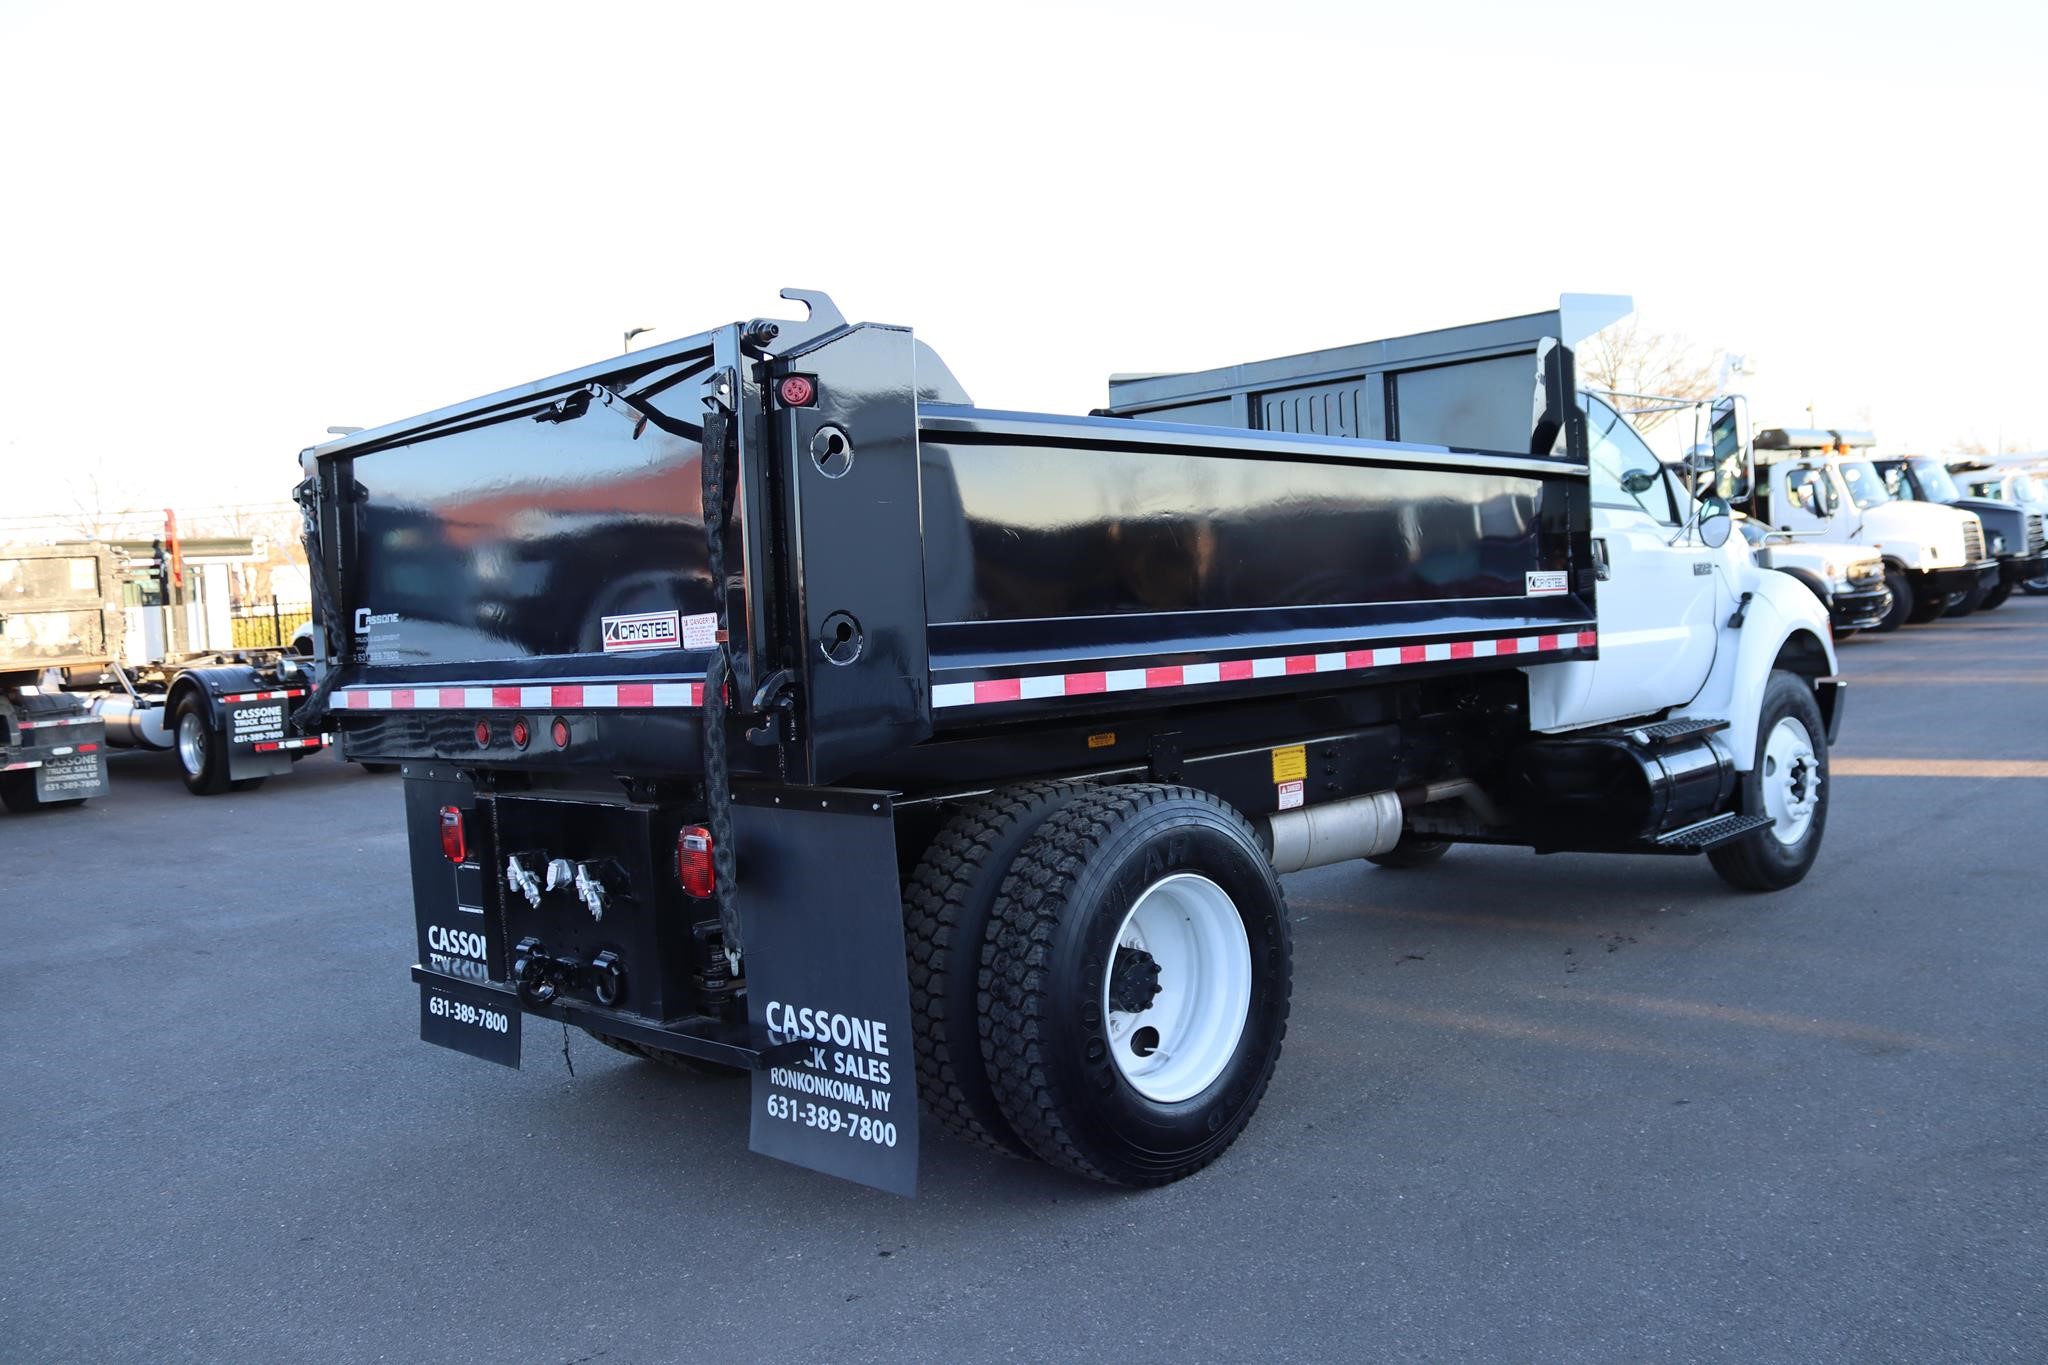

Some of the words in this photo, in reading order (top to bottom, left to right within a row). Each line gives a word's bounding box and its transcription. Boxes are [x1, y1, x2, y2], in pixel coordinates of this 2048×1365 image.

[355, 608, 399, 633] CASSONE
[620, 622, 674, 640] CRYSTEEL
[233, 705, 281, 719] CASSONE
[260, 715, 281, 724] SALES
[429, 996, 509, 1034] 631-389-7800
[765, 1000, 890, 1057] CASSONE
[833, 1052, 891, 1085] SALES
[770, 1067, 870, 1109] RONKONKOMA,
[871, 1089, 891, 1113] NY
[767, 1094, 897, 1148] 631-389-7800
